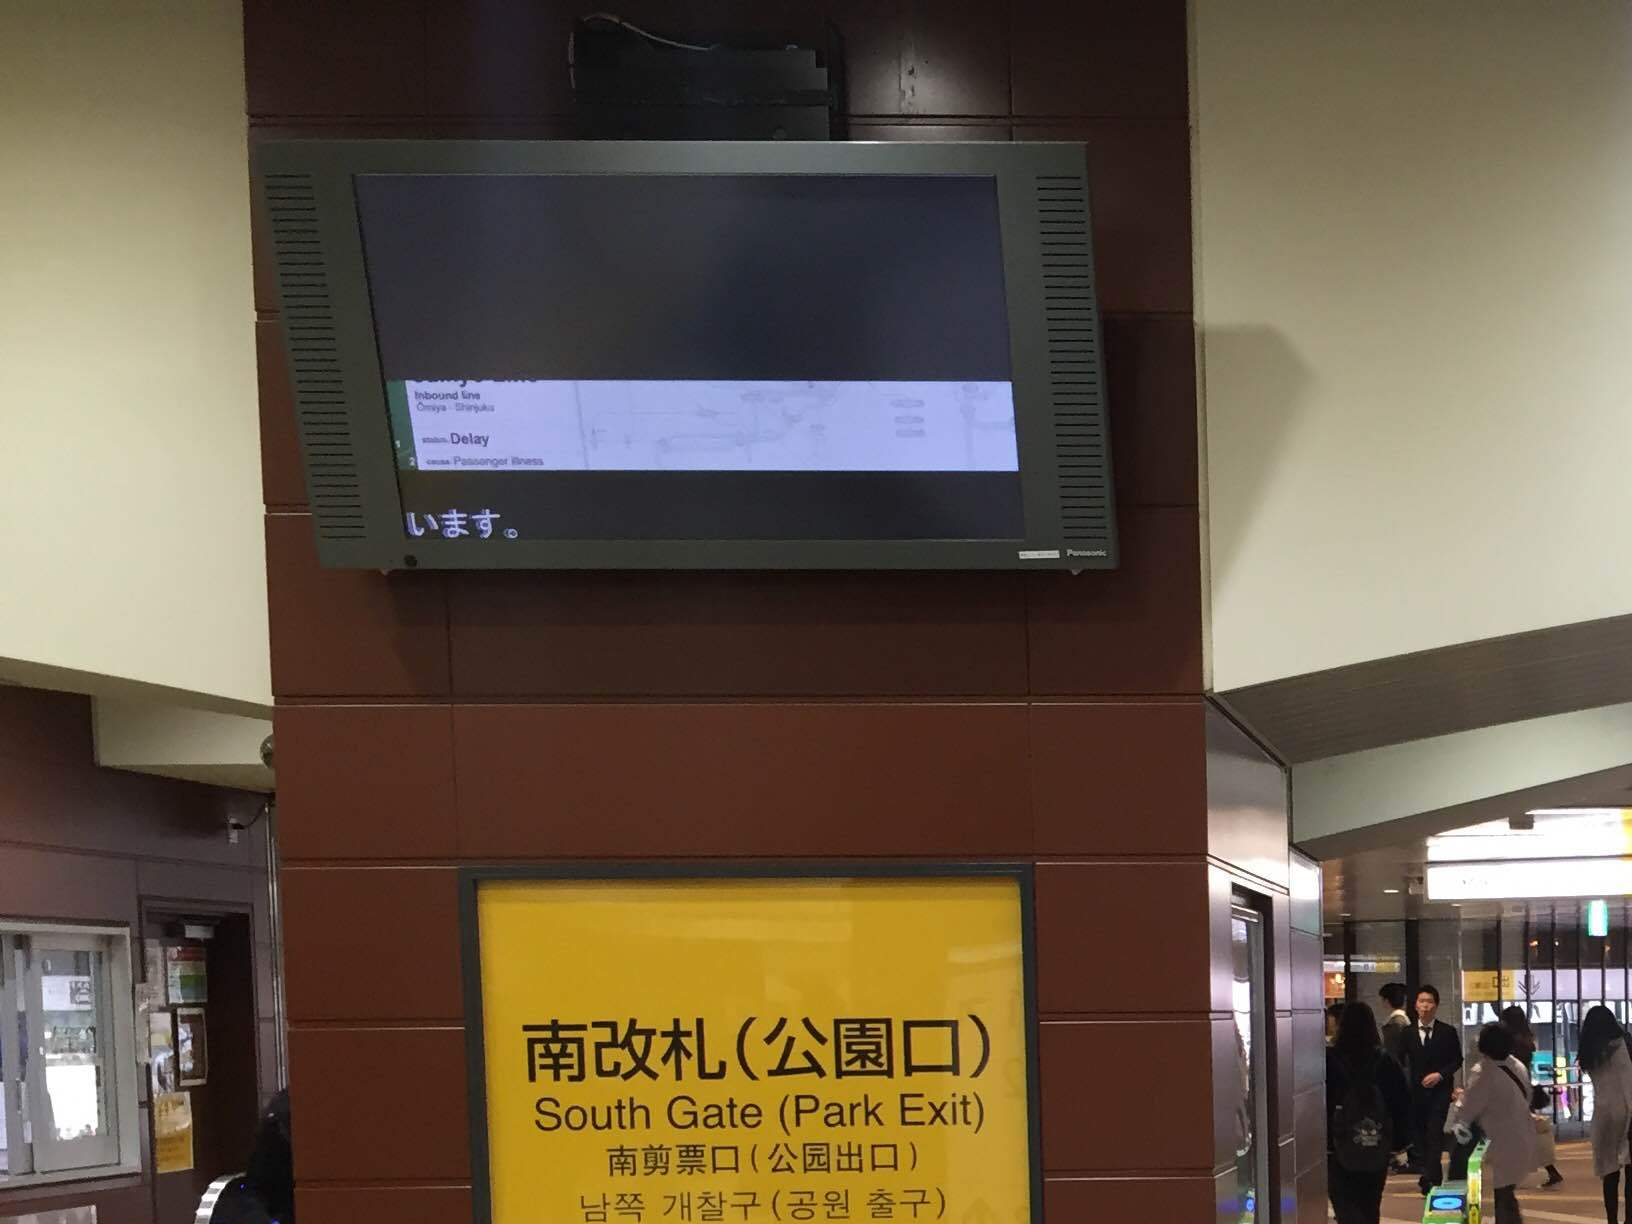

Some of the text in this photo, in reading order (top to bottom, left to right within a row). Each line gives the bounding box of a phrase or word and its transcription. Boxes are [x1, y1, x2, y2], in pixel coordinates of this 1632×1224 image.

[450, 433, 490, 447] Delay
[453, 456, 508, 467] Passenger
[406, 509, 519, 539] います。
[522, 1014, 992, 1083] 南改札(公園口)
[535, 1091, 985, 1134] South Gate (Park Exit)
[579, 1191, 646, 1223] 남쪽
[865, 1187, 947, 1220] 출구)
